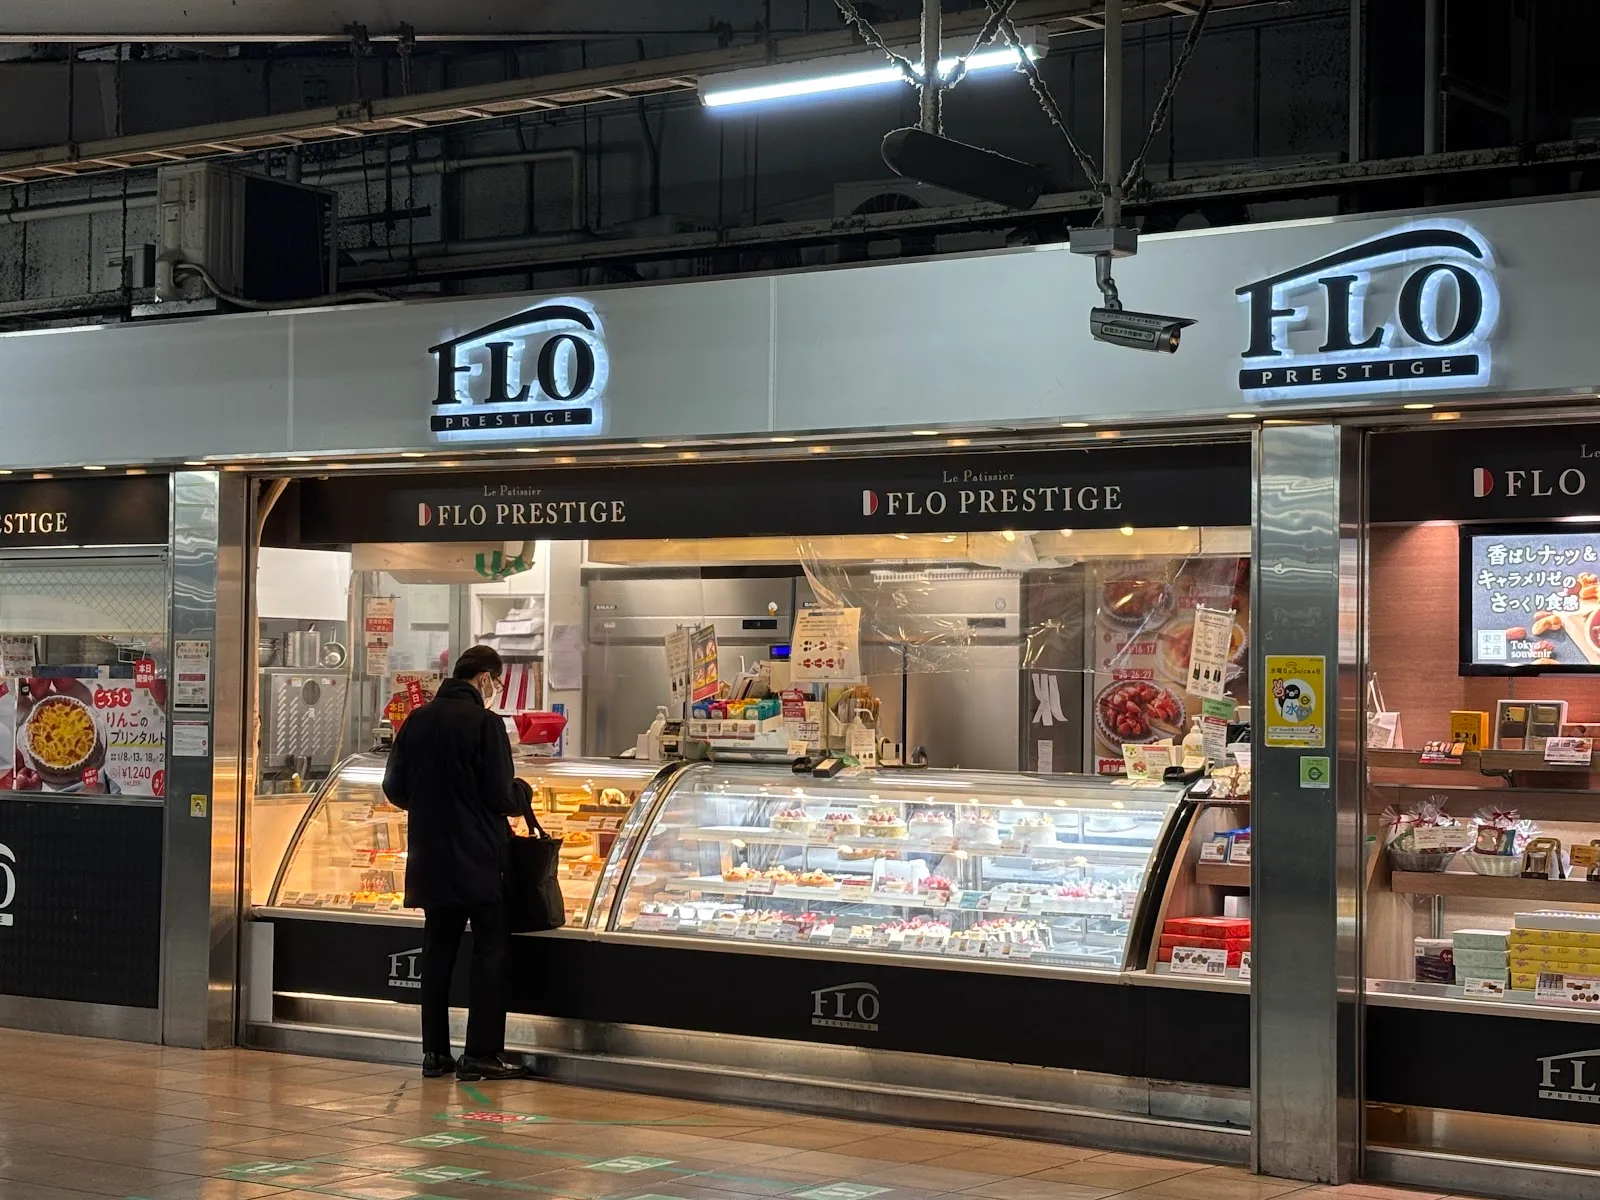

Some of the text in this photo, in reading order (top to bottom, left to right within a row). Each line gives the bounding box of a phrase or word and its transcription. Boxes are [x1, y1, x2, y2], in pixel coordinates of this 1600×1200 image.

[1235, 229, 1484, 358] FLO
[428, 305, 596, 405] FLO
[1261, 359, 1453, 386] PRESTIGE
[445, 411, 573, 428] PRESTIGE
[943, 469, 1015, 483] Le Patissier
[1505, 468, 1586, 497] FLO
[483, 485, 542, 497] Le Patissier
[887, 486, 1123, 516] FLO PRESTIGE
[437, 500, 627, 526] FLO PRESTIGE
[1477, 569, 1577, 590] キャラメリゼの
[1490, 593, 1580, 613] さっくり食感
[1482, 634, 1502, 644] 東京
[1510, 640, 1541, 651] Tokyo
[1482, 645, 1502, 655] 土産
[1510, 649, 1552, 658] souvenir
[139, 664, 152, 673] 本日
[389, 702, 405, 712] 本日
[1285, 702, 1298, 716] 水
[106, 709, 148, 728] りんごの
[122, 766, 151, 779] ¥1,240
[388, 948, 423, 979] FL
[811, 982, 880, 1021] FLO
[817, 1019, 872, 1030] PRESTIGE
[1536, 1049, 1600, 1092] FL
